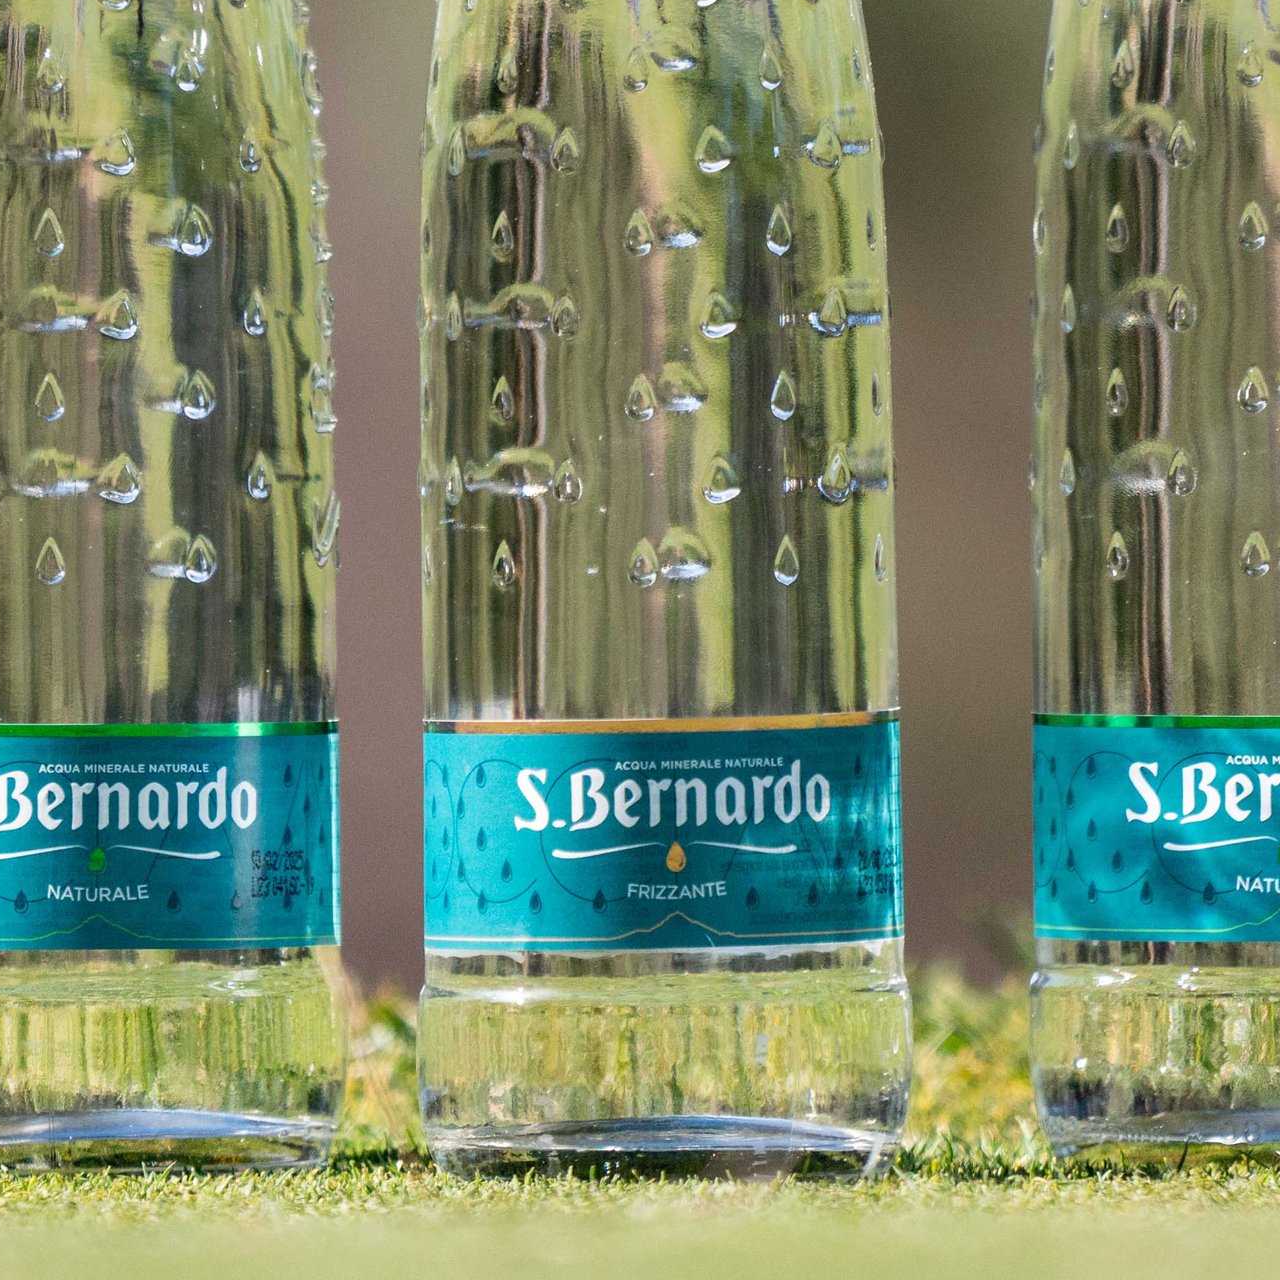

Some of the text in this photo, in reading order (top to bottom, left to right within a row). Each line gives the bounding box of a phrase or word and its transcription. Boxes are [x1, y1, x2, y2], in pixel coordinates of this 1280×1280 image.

[38, 762, 210, 775] ACQUA MINERALE NATURALE
[614, 756, 784, 772] ACQUA MINERALE NATURALE
[1225, 755, 1269, 766] ACQUA
[513, 758, 831, 833] S.Bernardo
[46, 883, 151, 903] NATURALE
[626, 880, 728, 901] FRIZZANTE
